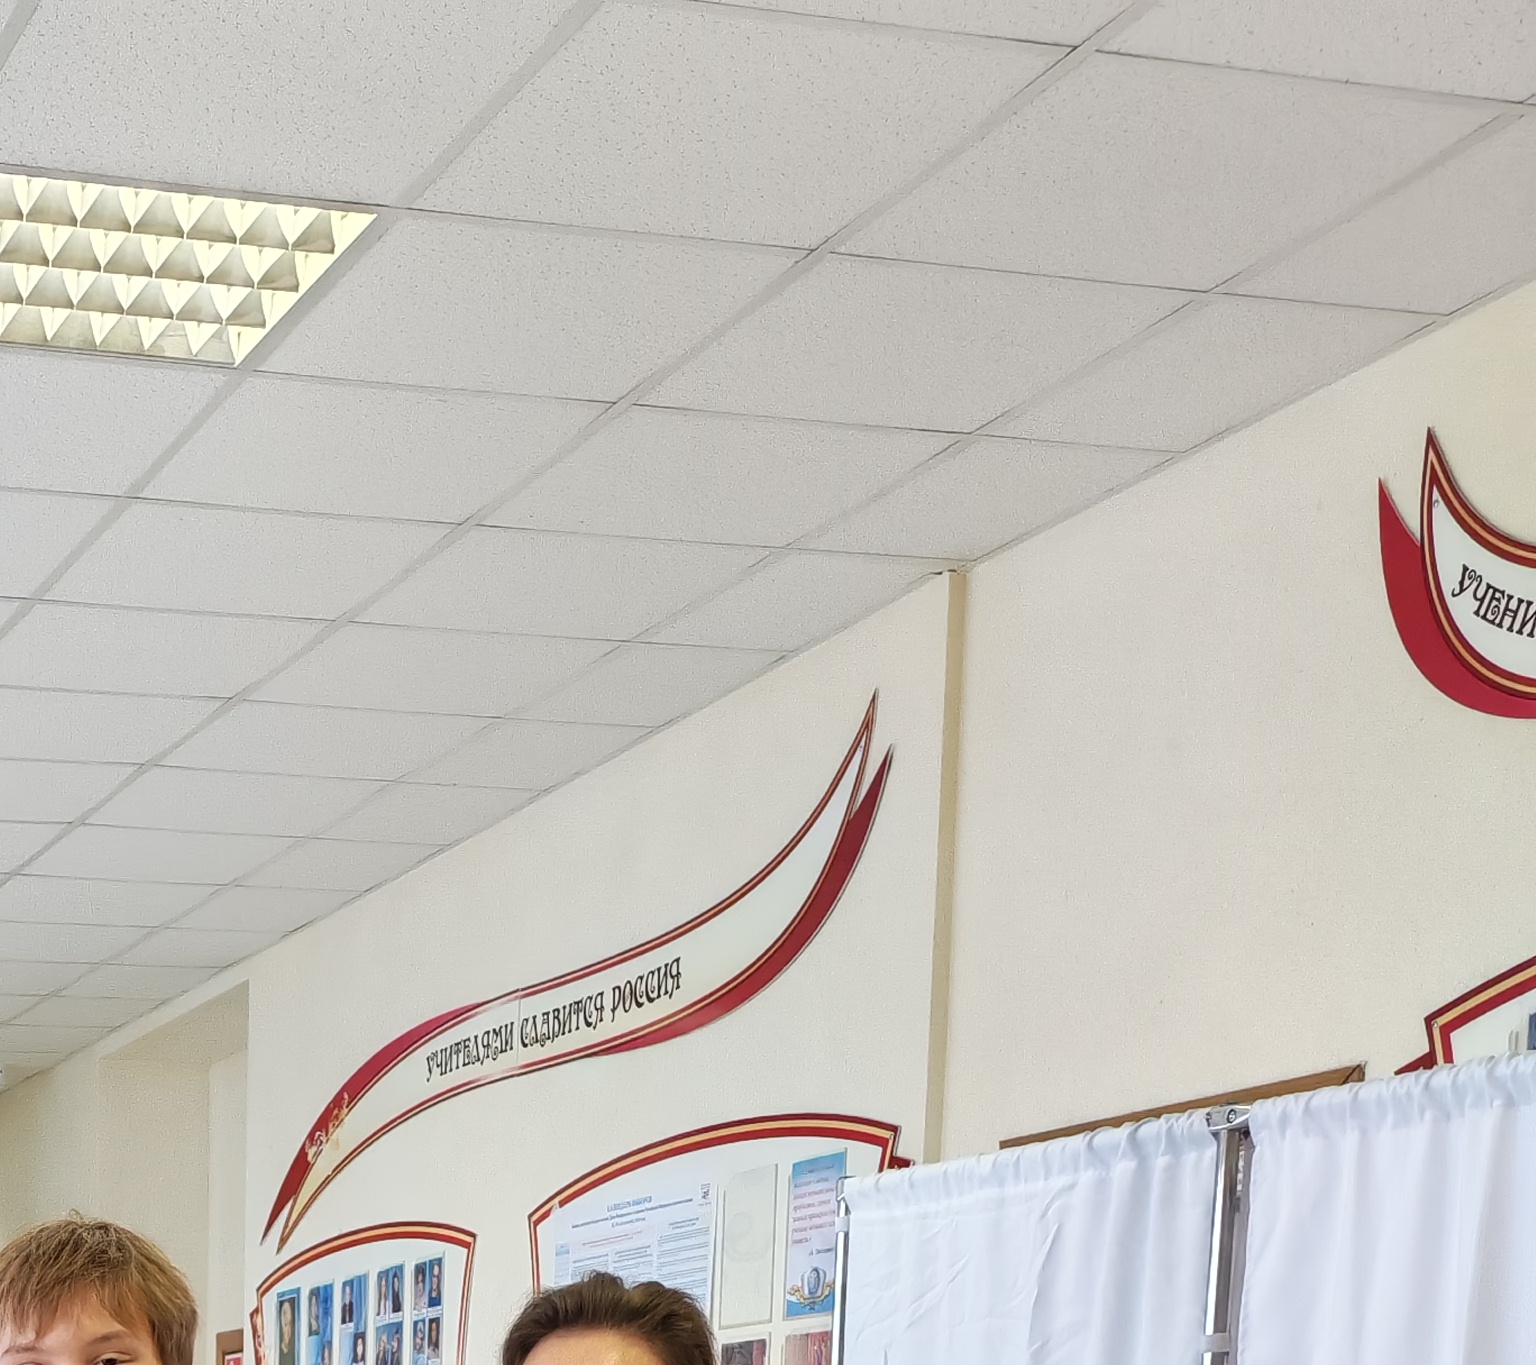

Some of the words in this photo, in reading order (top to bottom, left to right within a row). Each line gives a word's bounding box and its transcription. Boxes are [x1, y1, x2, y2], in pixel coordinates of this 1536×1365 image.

[1451, 563, 1536, 639] УЧЕНИ
[425, 1021, 515, 1082] УЧИТЕЛЯМИ
[520, 991, 605, 1049] СЛАВИТСЯ
[610, 956, 682, 1023] РОССИЯ
